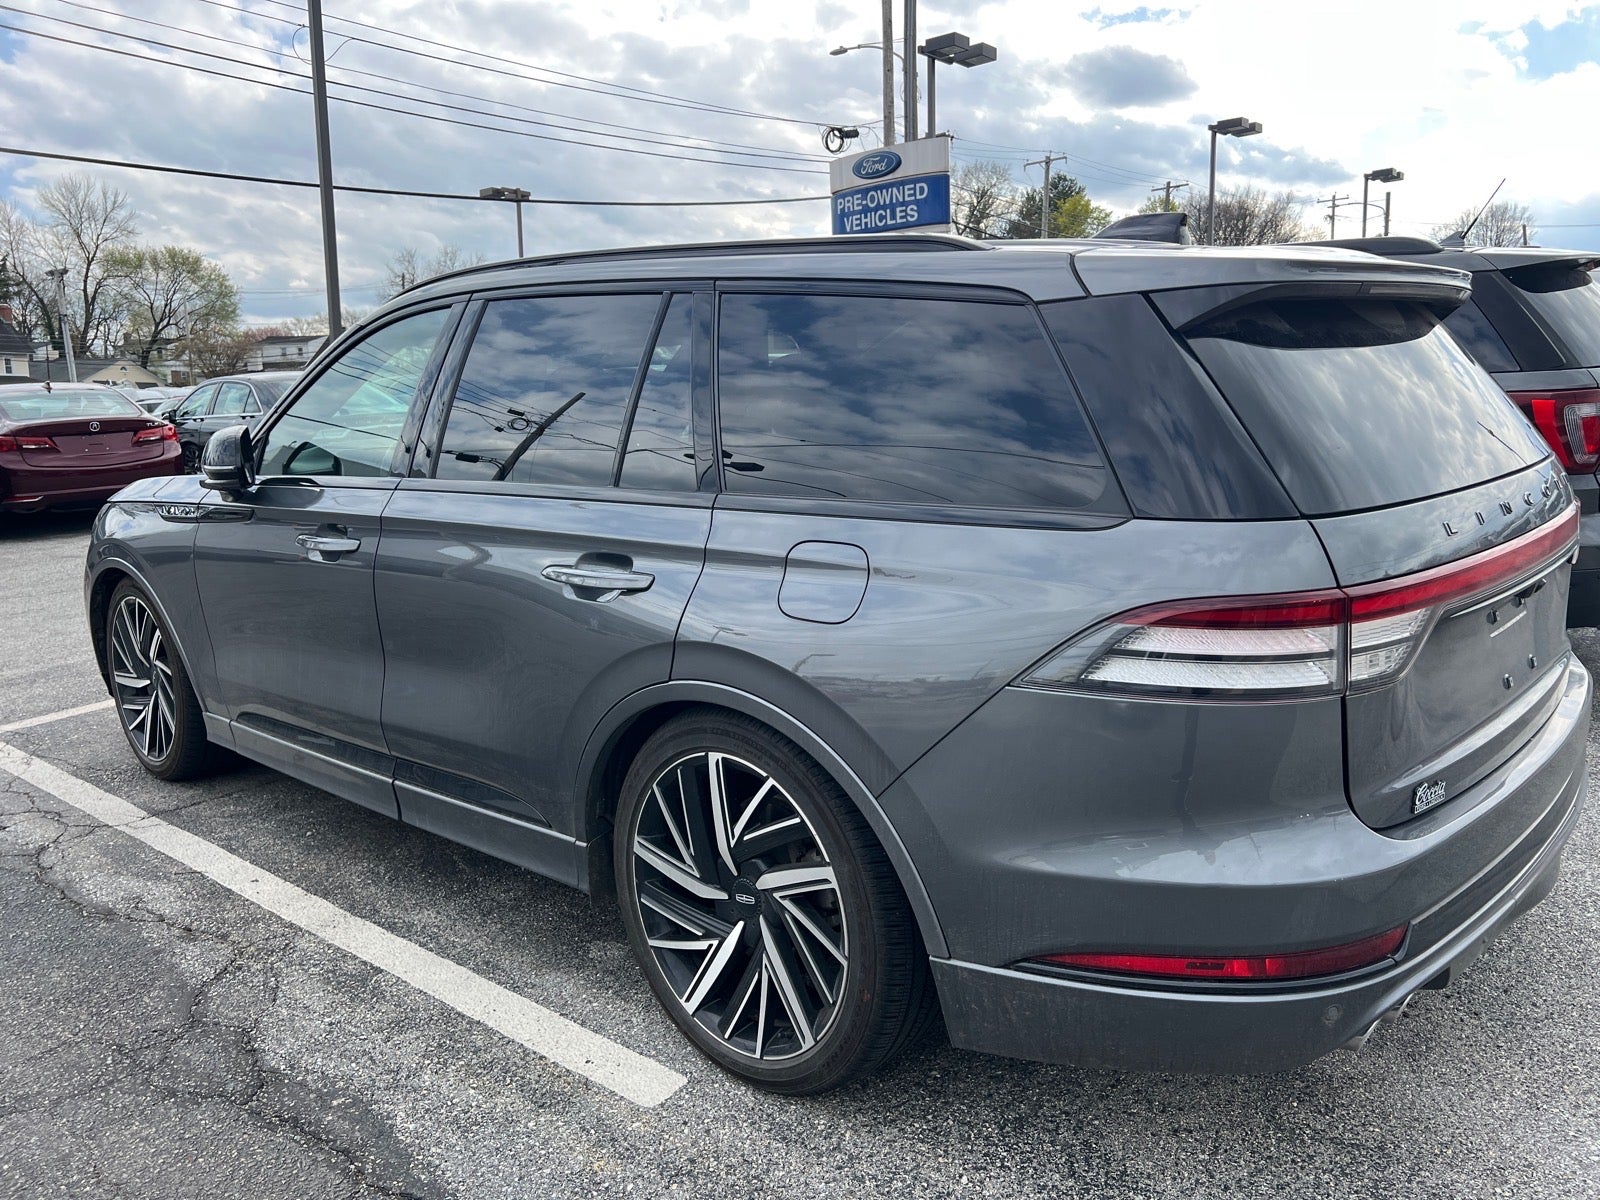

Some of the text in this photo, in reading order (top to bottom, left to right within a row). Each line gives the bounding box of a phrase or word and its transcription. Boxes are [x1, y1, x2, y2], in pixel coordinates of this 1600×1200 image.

[860, 156, 887, 174] Ford
[837, 182, 928, 214] PRE-OWNED
[844, 204, 918, 232] VEHICLES
